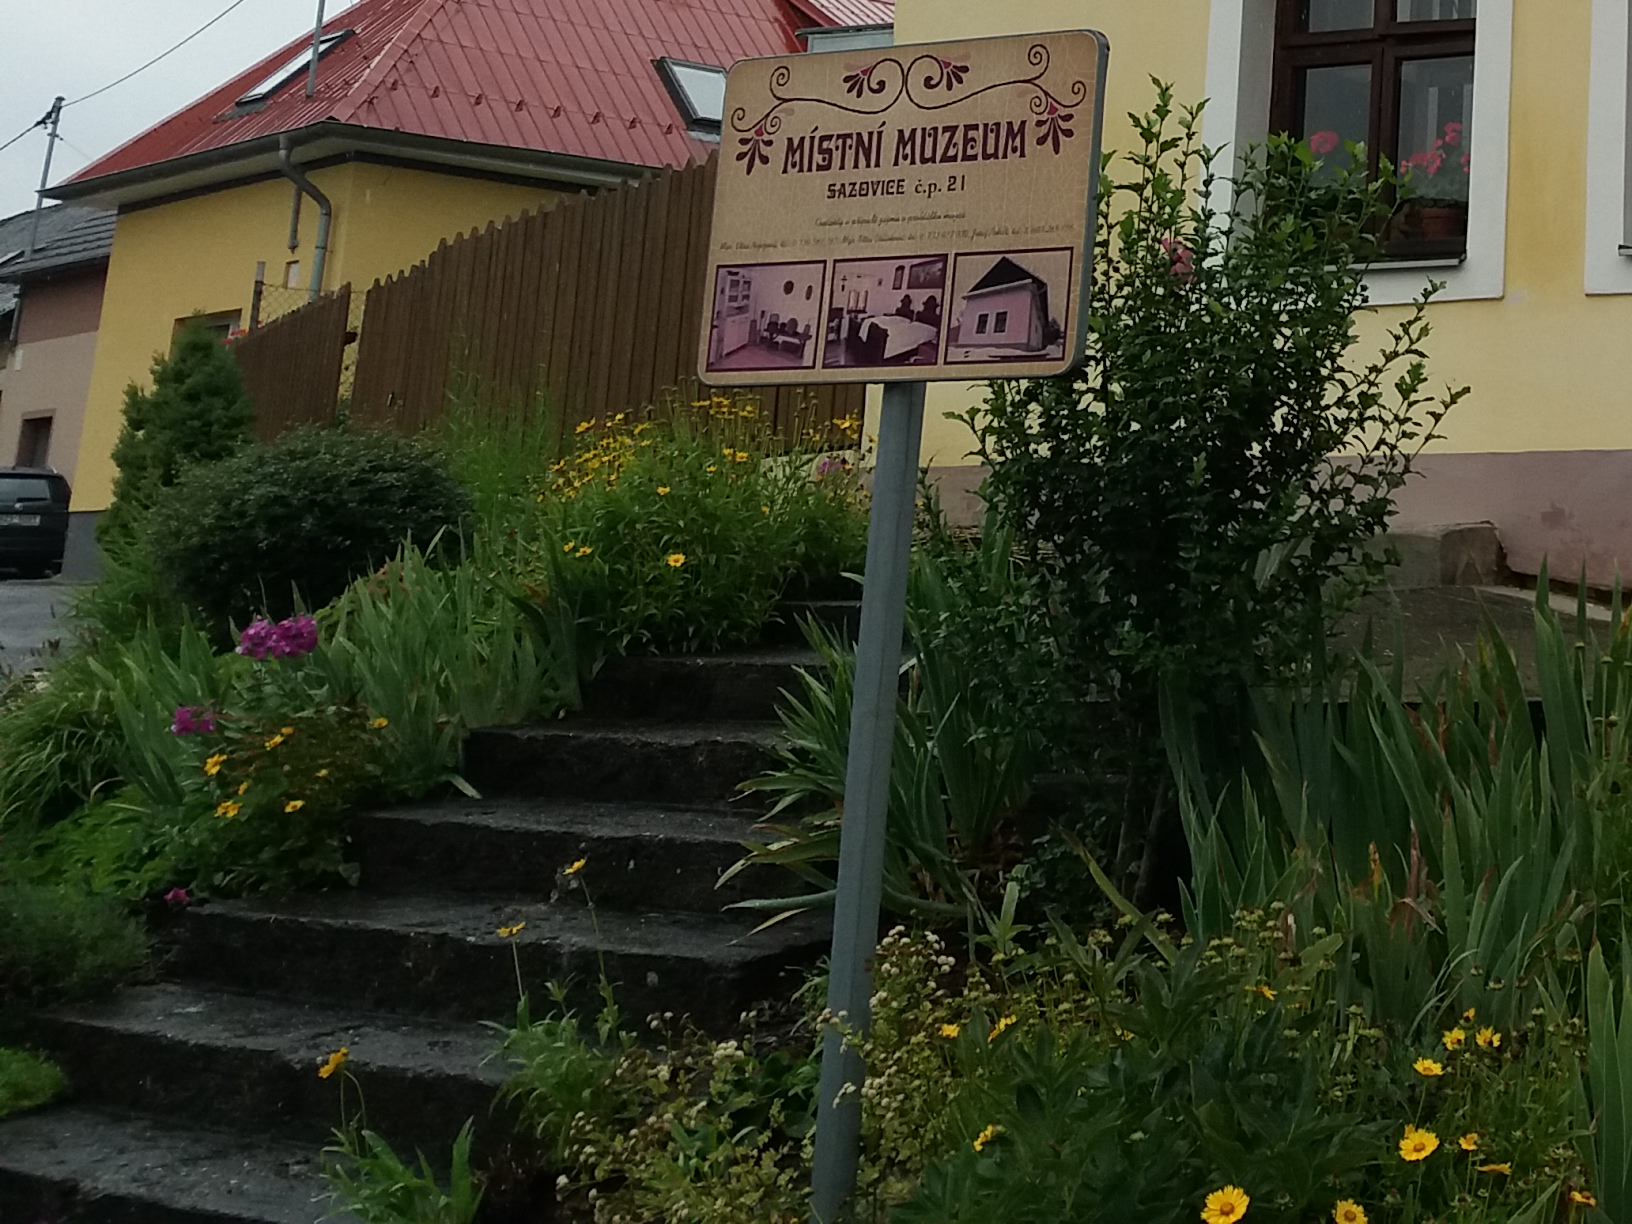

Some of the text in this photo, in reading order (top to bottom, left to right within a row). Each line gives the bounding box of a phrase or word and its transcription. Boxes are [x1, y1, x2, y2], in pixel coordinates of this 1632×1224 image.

[781, 119, 1028, 174] MÍSTNÍ MUZEUM
[826, 174, 966, 199] SAZOVICE č.p. 21
